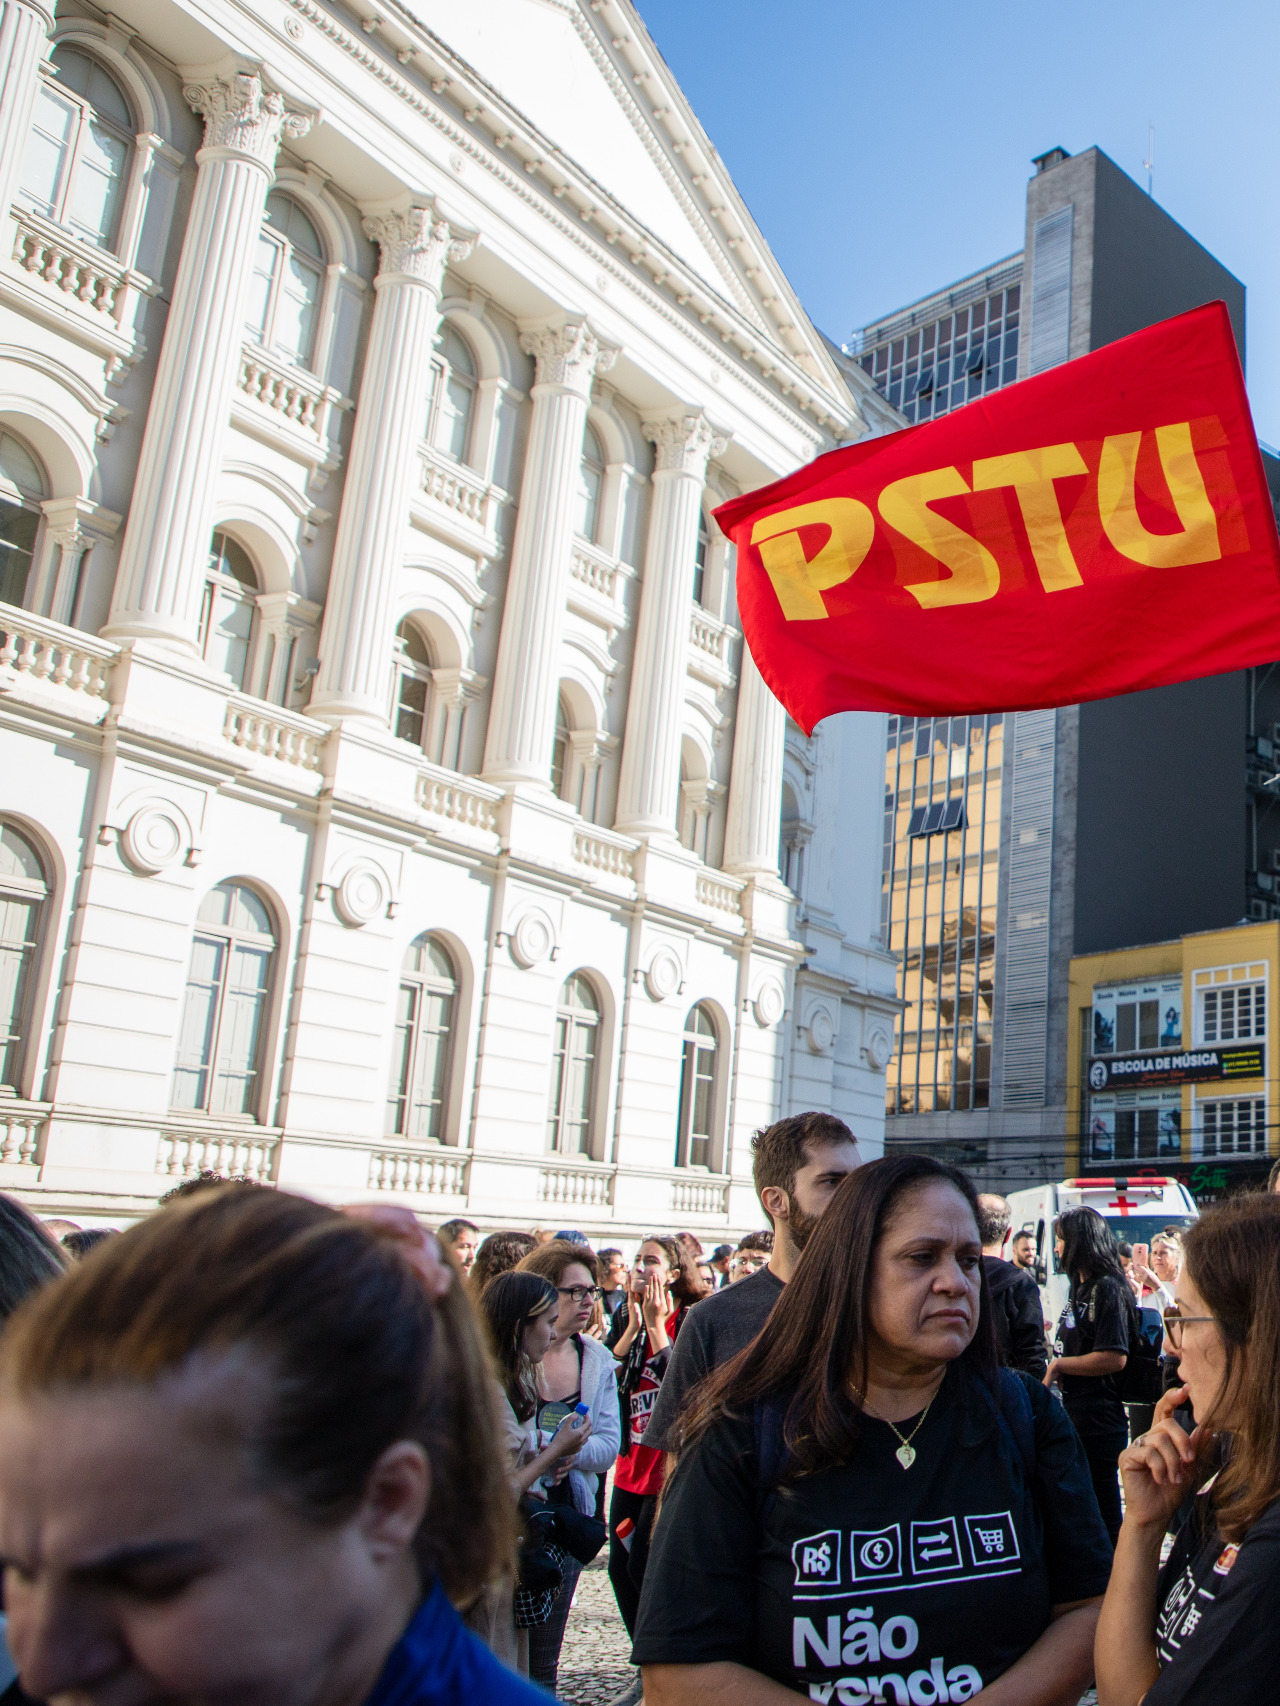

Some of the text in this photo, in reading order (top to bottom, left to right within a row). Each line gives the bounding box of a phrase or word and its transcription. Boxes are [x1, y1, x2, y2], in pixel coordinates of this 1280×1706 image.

[751, 422, 1222, 621] PSTU
[1111, 1059, 1154, 1075] ESCOLA
[1155, 1057, 1171, 1070] DE
[1172, 1052, 1219, 1069] MÚSICA
[802, 1541, 832, 1577] R$
[792, 1605, 920, 1669] Não
[800, 1656, 984, 1706] venda
